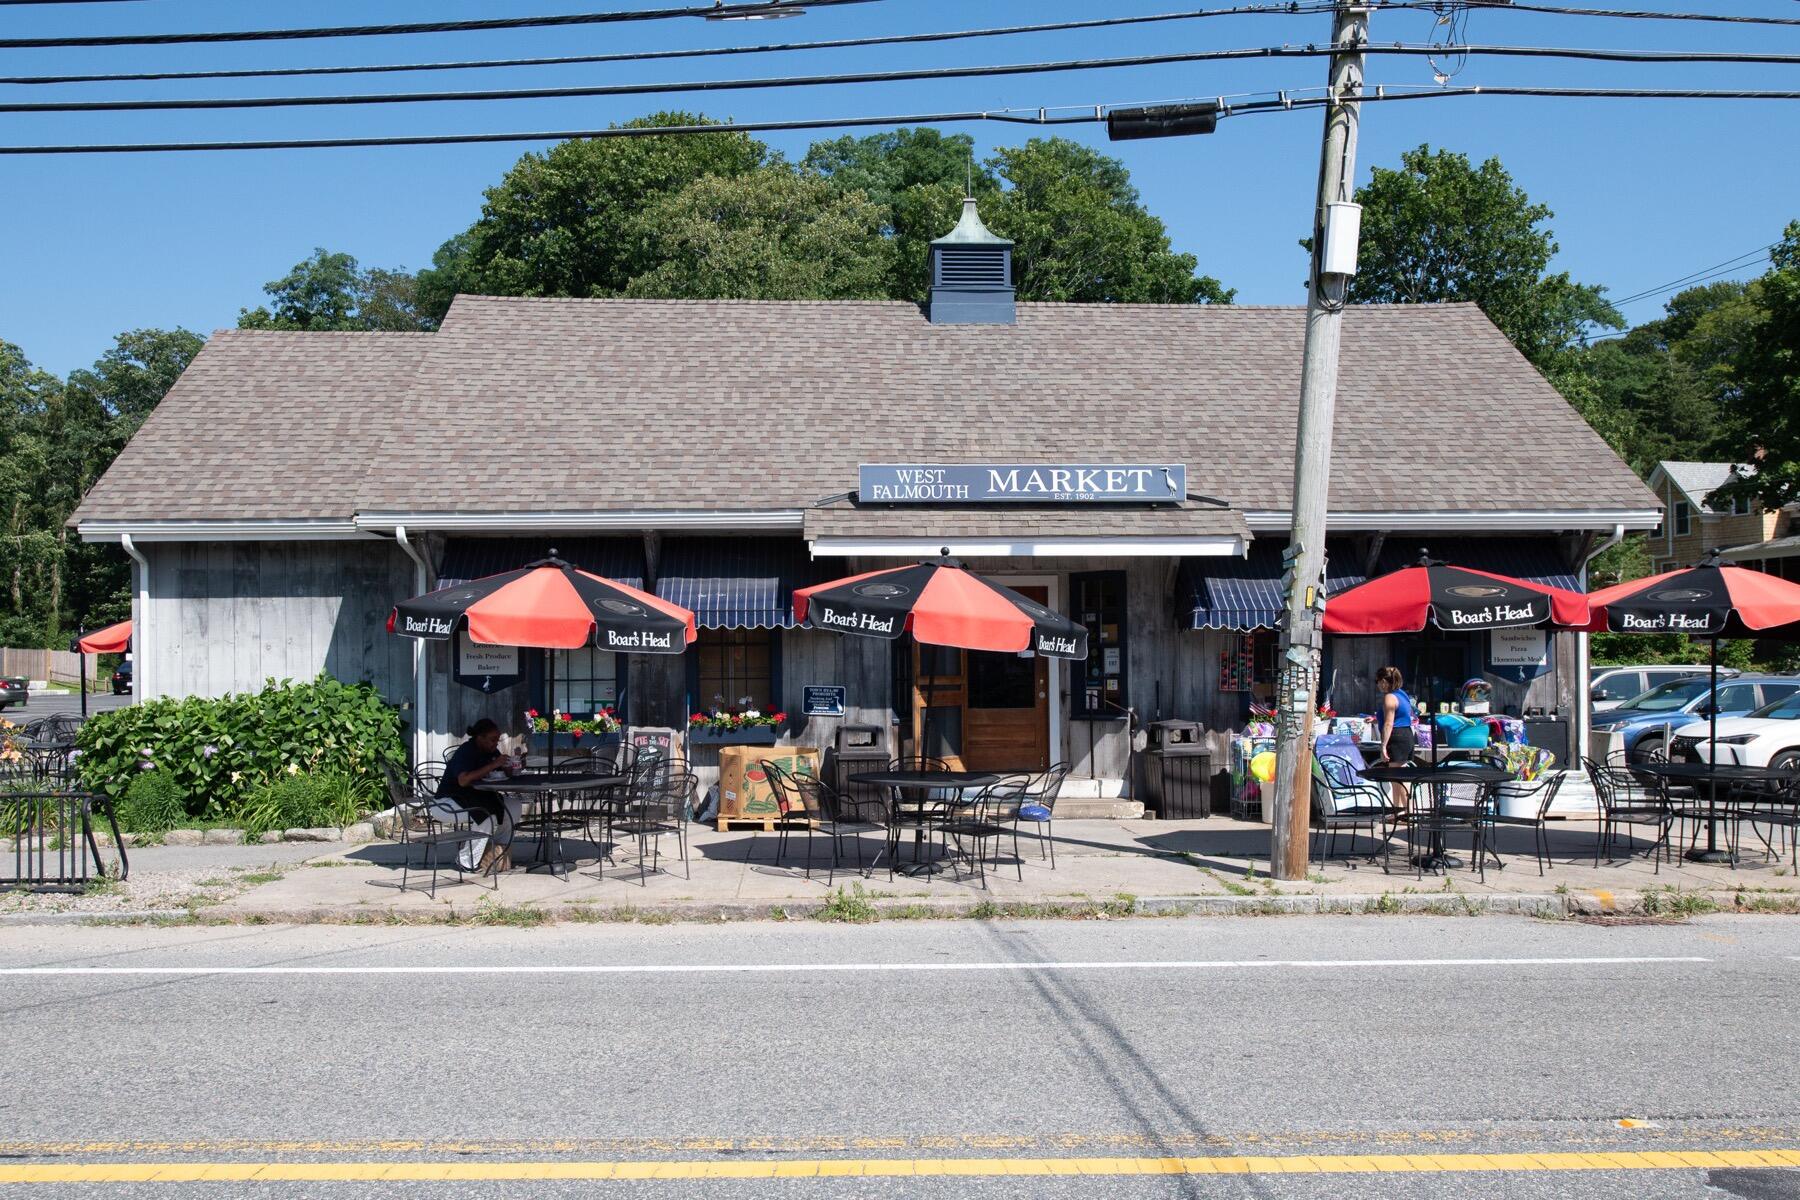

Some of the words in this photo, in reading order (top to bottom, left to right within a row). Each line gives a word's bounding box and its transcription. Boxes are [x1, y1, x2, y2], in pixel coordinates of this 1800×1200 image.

[896, 469, 946, 484] WEST
[986, 469, 1153, 492] MARKET
[872, 485, 969, 499] FALMOUTH
[822, 608, 858, 627] Boar's
[859, 613, 894, 633] Head
[1451, 607, 1493, 625] Boar's
[1494, 602, 1534, 621] Head
[1622, 613, 1665, 628] Boar's
[1667, 613, 1710, 628] Head
[406, 616, 429, 632] Boar's
[428, 618, 453, 634] Head
[608, 630, 640, 647] Boar's
[641, 631, 671, 648] Head
[1039, 634, 1056, 651] Boar's
[1055, 637, 1077, 654] Head
[477, 664, 500, 672] Bakery
